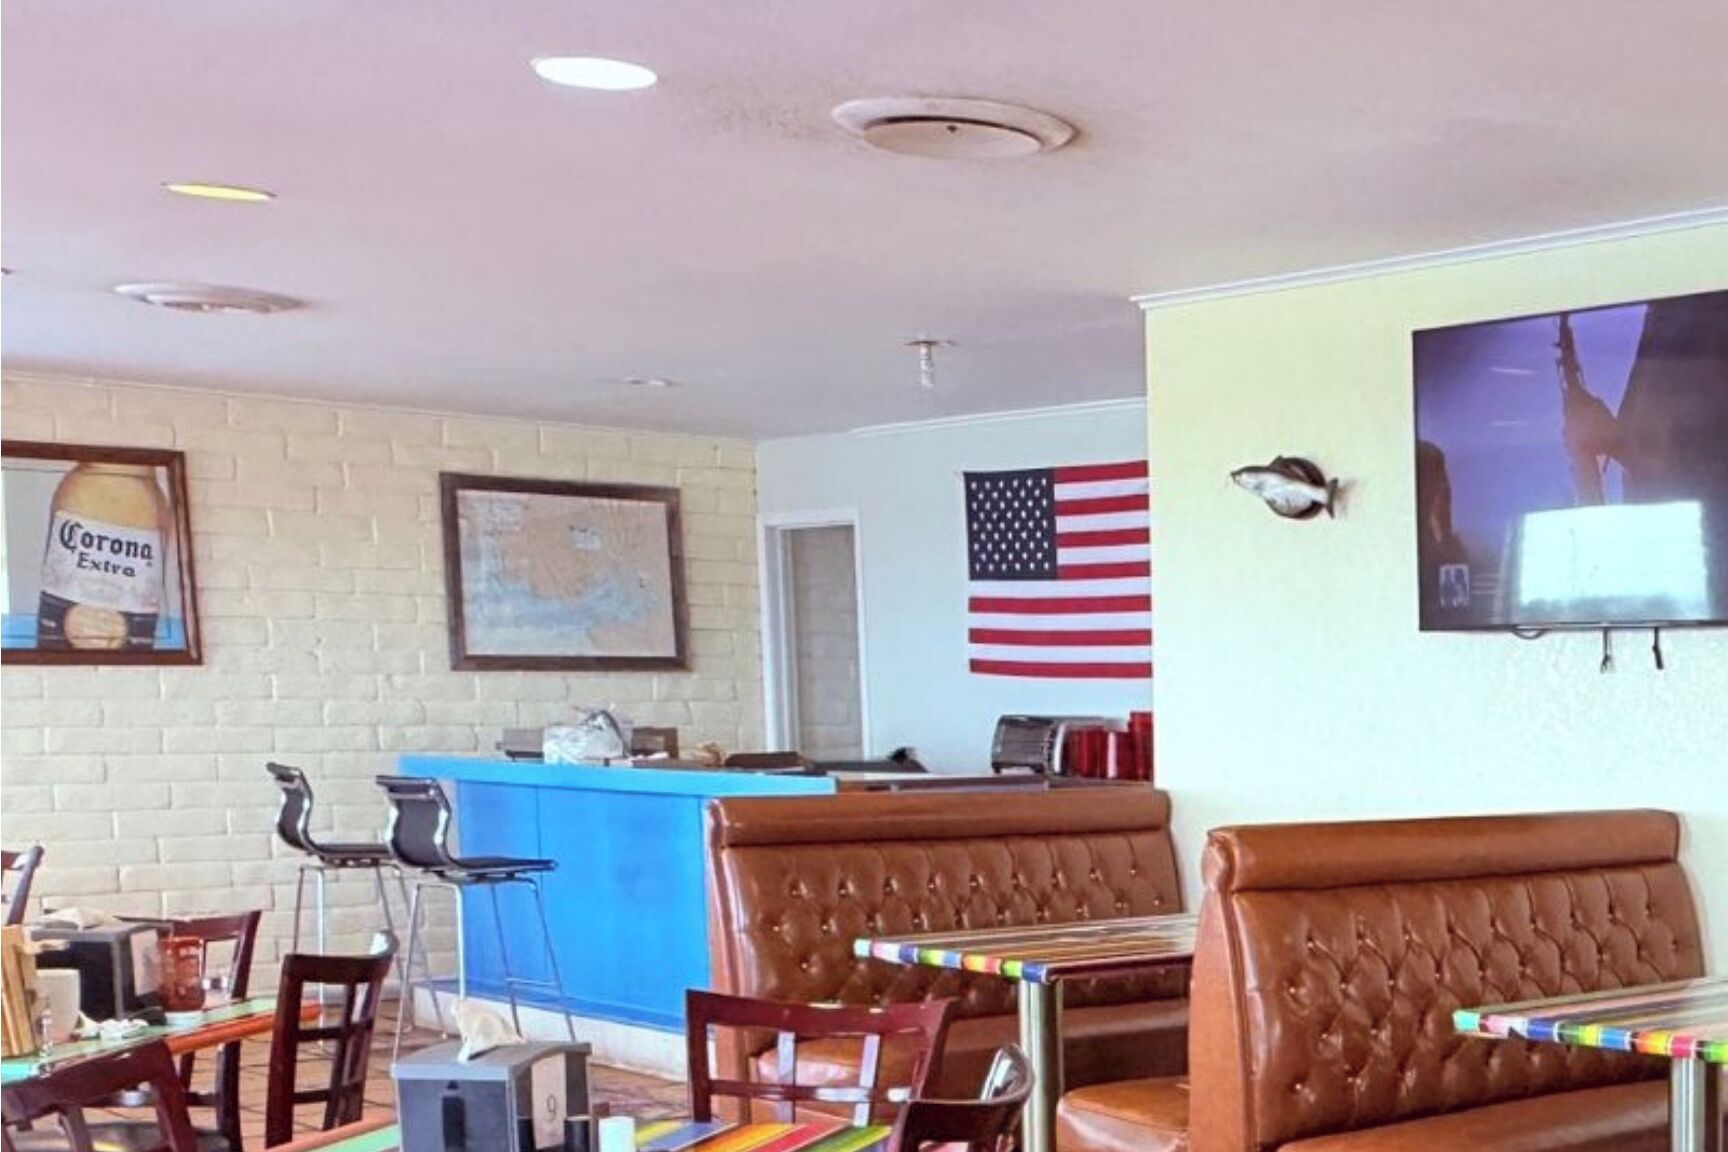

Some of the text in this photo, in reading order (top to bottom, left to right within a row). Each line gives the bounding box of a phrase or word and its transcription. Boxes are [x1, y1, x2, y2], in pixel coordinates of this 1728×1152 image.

[58, 518, 154, 562] Corona
[76, 550, 137, 578] Extra
[546, 1092, 557, 1123] 9
